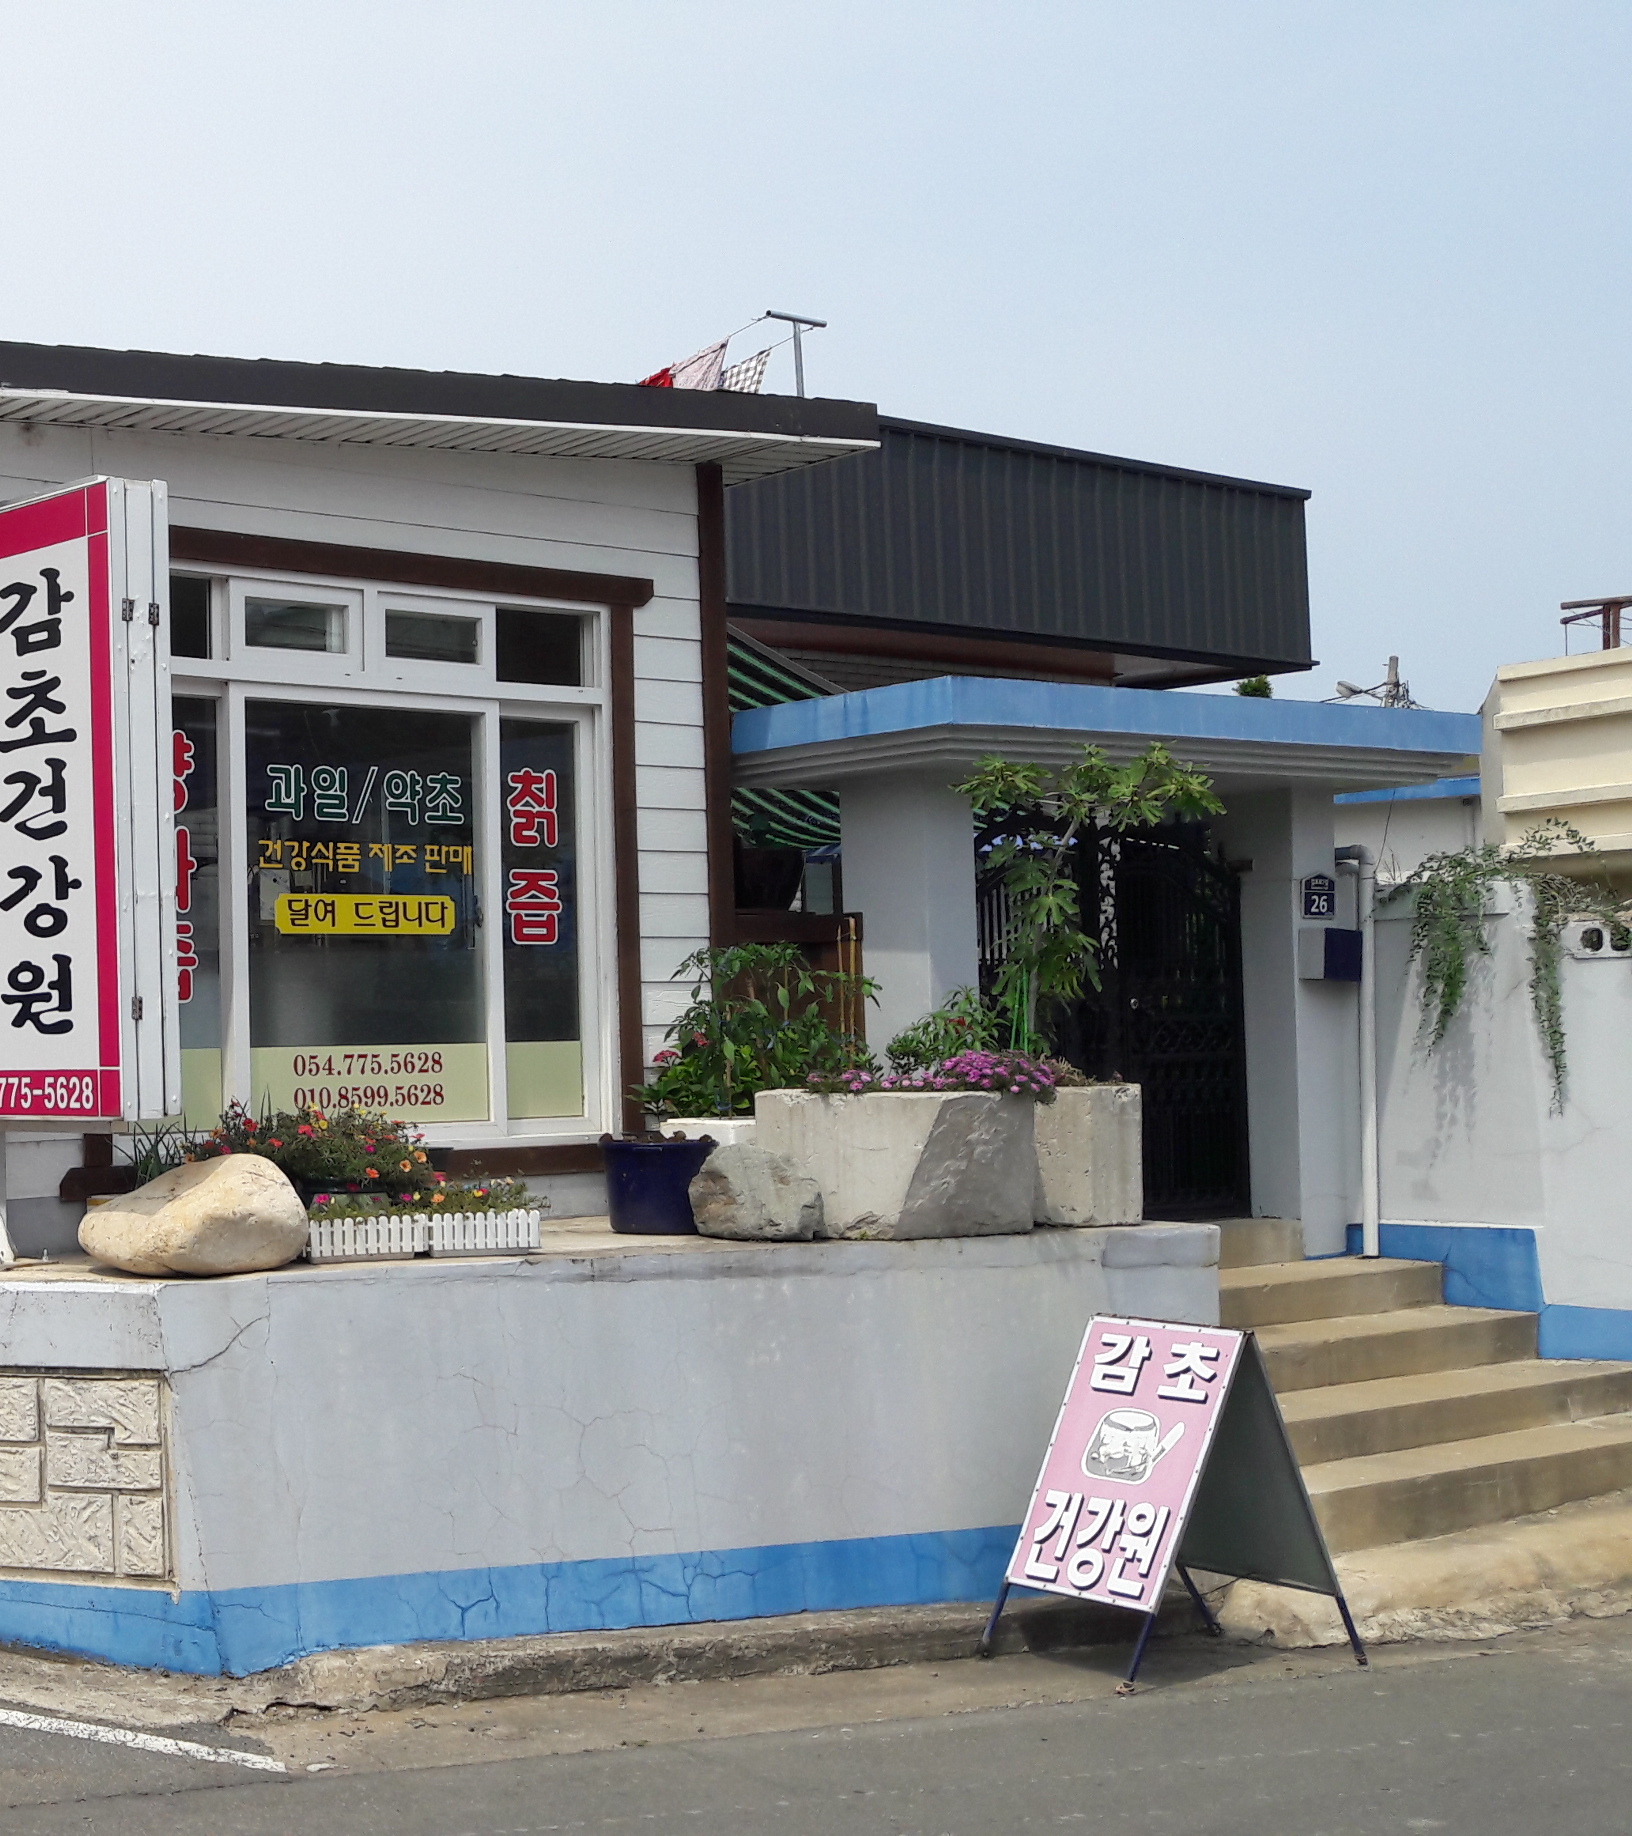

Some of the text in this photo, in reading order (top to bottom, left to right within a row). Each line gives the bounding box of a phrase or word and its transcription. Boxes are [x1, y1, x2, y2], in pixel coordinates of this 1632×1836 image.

[265, 764, 465, 826] 과일/약초
[258, 839, 473, 875] 건강식품 제조 판매
[506, 767, 563, 946] 칡즙
[287, 899, 449, 929] 달여 드립니다
[1310, 895, 1328, 913] 26
[293, 1051, 443, 1077] 054.775.5628
[293, 1083, 445, 1110] 010.8599.5628
[1089, 1332, 1222, 1404] 감초
[1023, 1488, 1171, 1600] 건강원
